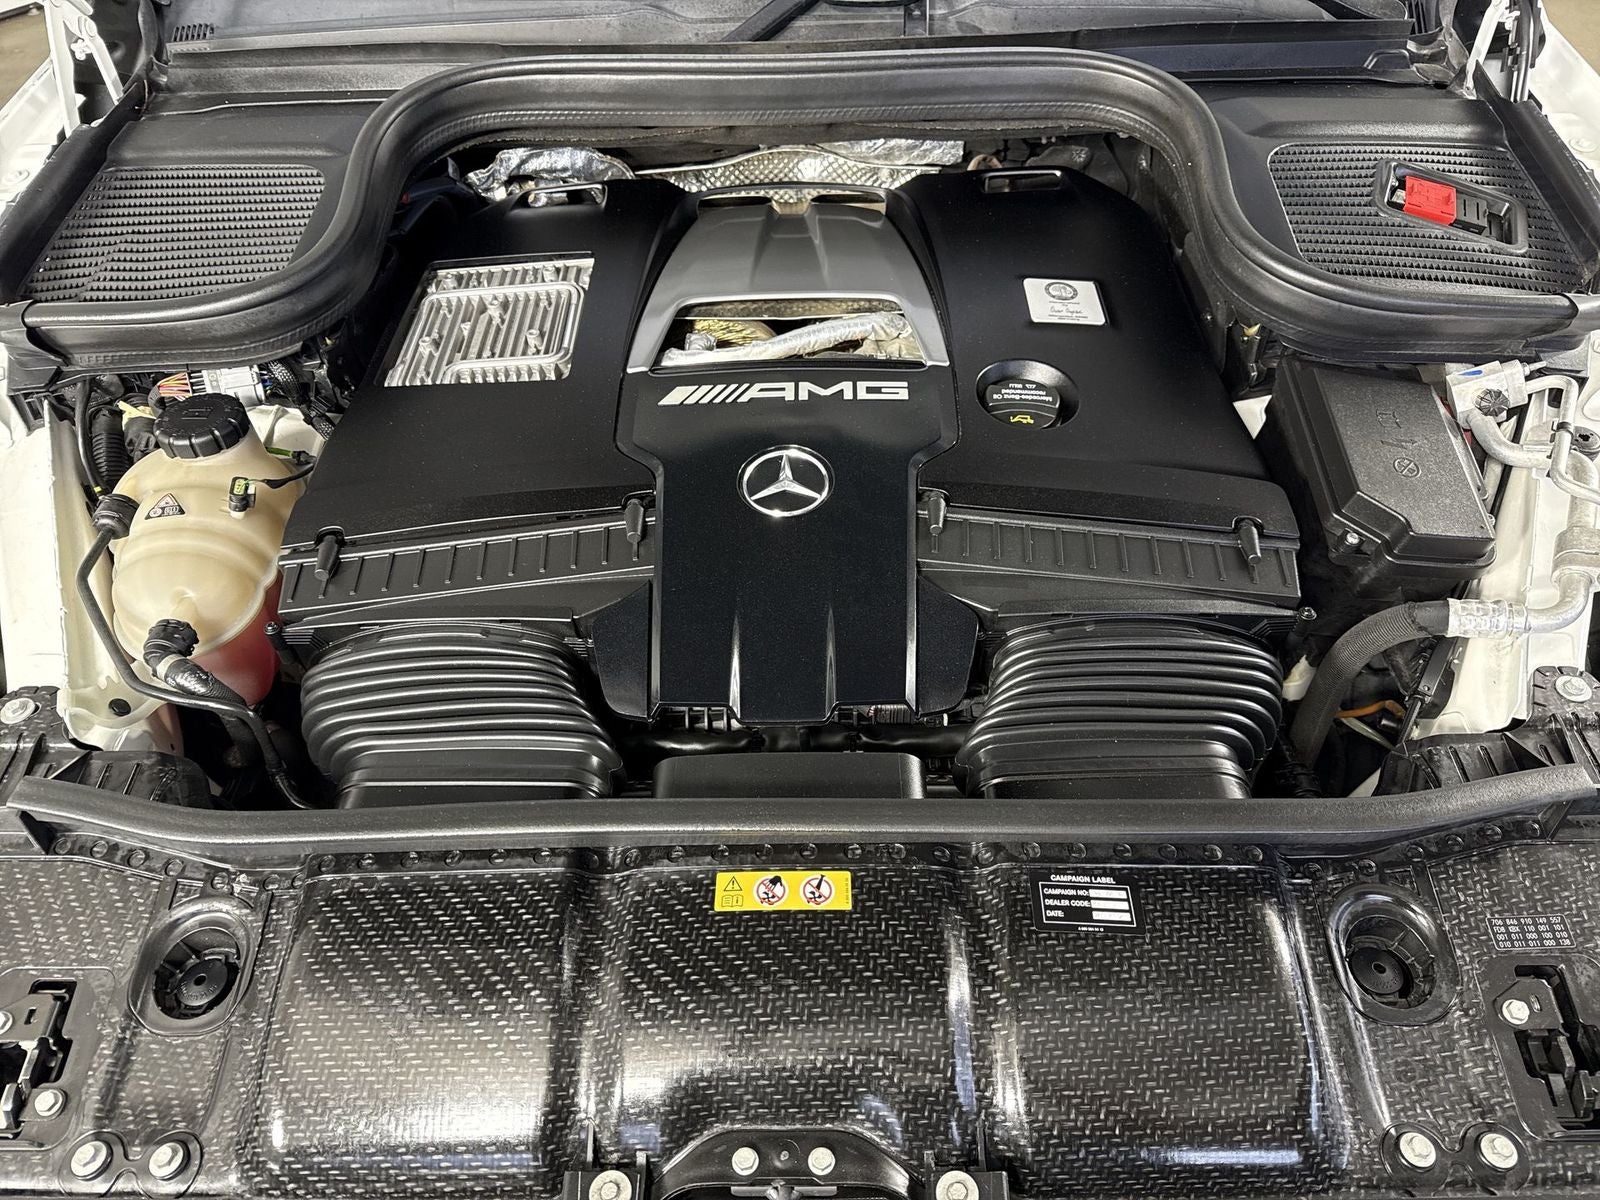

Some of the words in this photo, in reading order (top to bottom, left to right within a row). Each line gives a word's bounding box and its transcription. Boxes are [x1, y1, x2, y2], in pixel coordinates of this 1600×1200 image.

[737, 381, 909, 403] AMG
[1003, 393, 1053, 402] Mercedes-Benz
[1050, 874, 1090, 883] CAMPAIGN
[1092, 876, 1116, 884] LABEL
[1538, 924, 1550, 932] 001
[1526, 932, 1538, 940] 000
